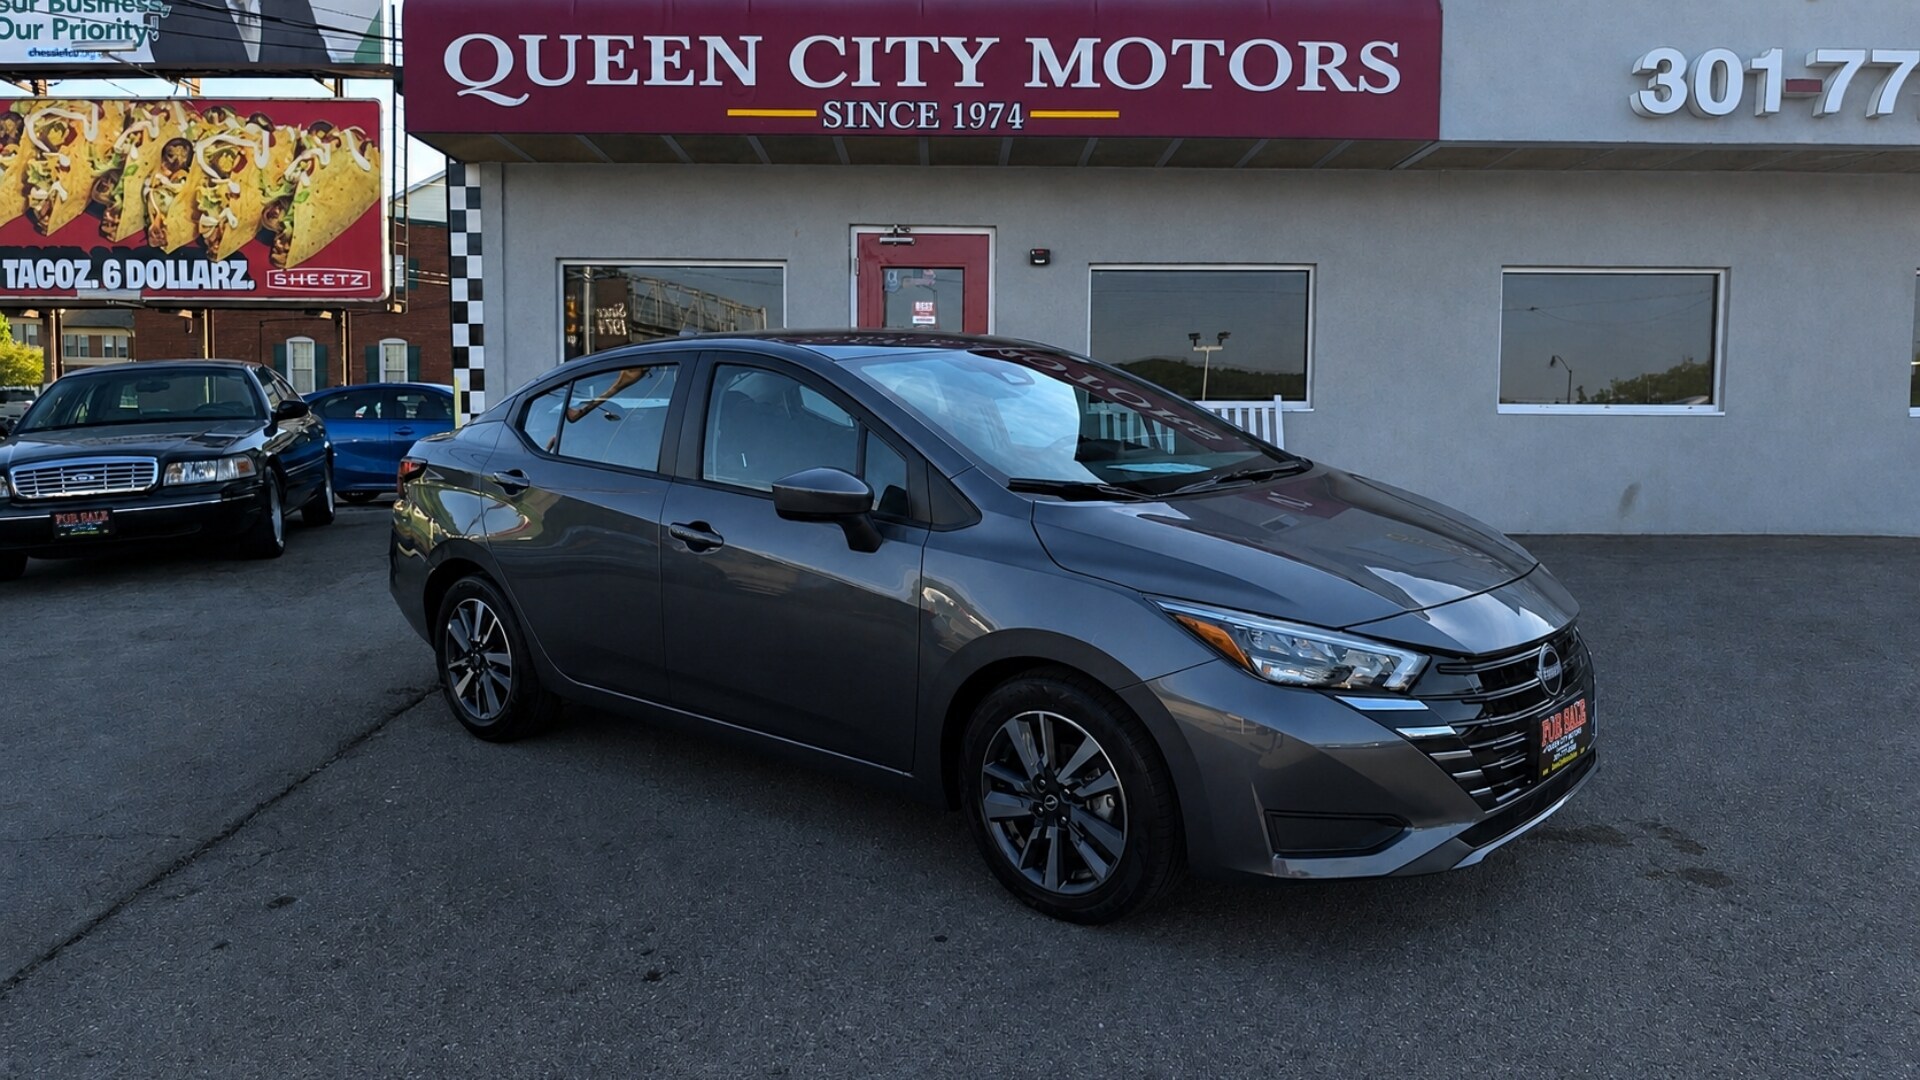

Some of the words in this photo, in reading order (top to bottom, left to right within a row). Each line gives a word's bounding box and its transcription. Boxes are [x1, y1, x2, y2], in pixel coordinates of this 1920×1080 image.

[0, 16, 43, 40] Our
[443, 33, 763, 107] QUEEN
[789, 35, 1000, 88] CITY
[1024, 37, 1401, 94] MOTORS
[822, 101, 940, 130] SINCE
[953, 102, 1024, 130] 1974
[2, 258, 99, 289] TACOZ.
[102, 258, 122, 290] 6
[126, 259, 255, 290] DOLLARZ.
[274, 273, 364, 286] SHEETZ
[55, 513, 79, 524] FOR
[1541, 713, 1562, 748] FOR
[1564, 698, 1587, 734] SALE
